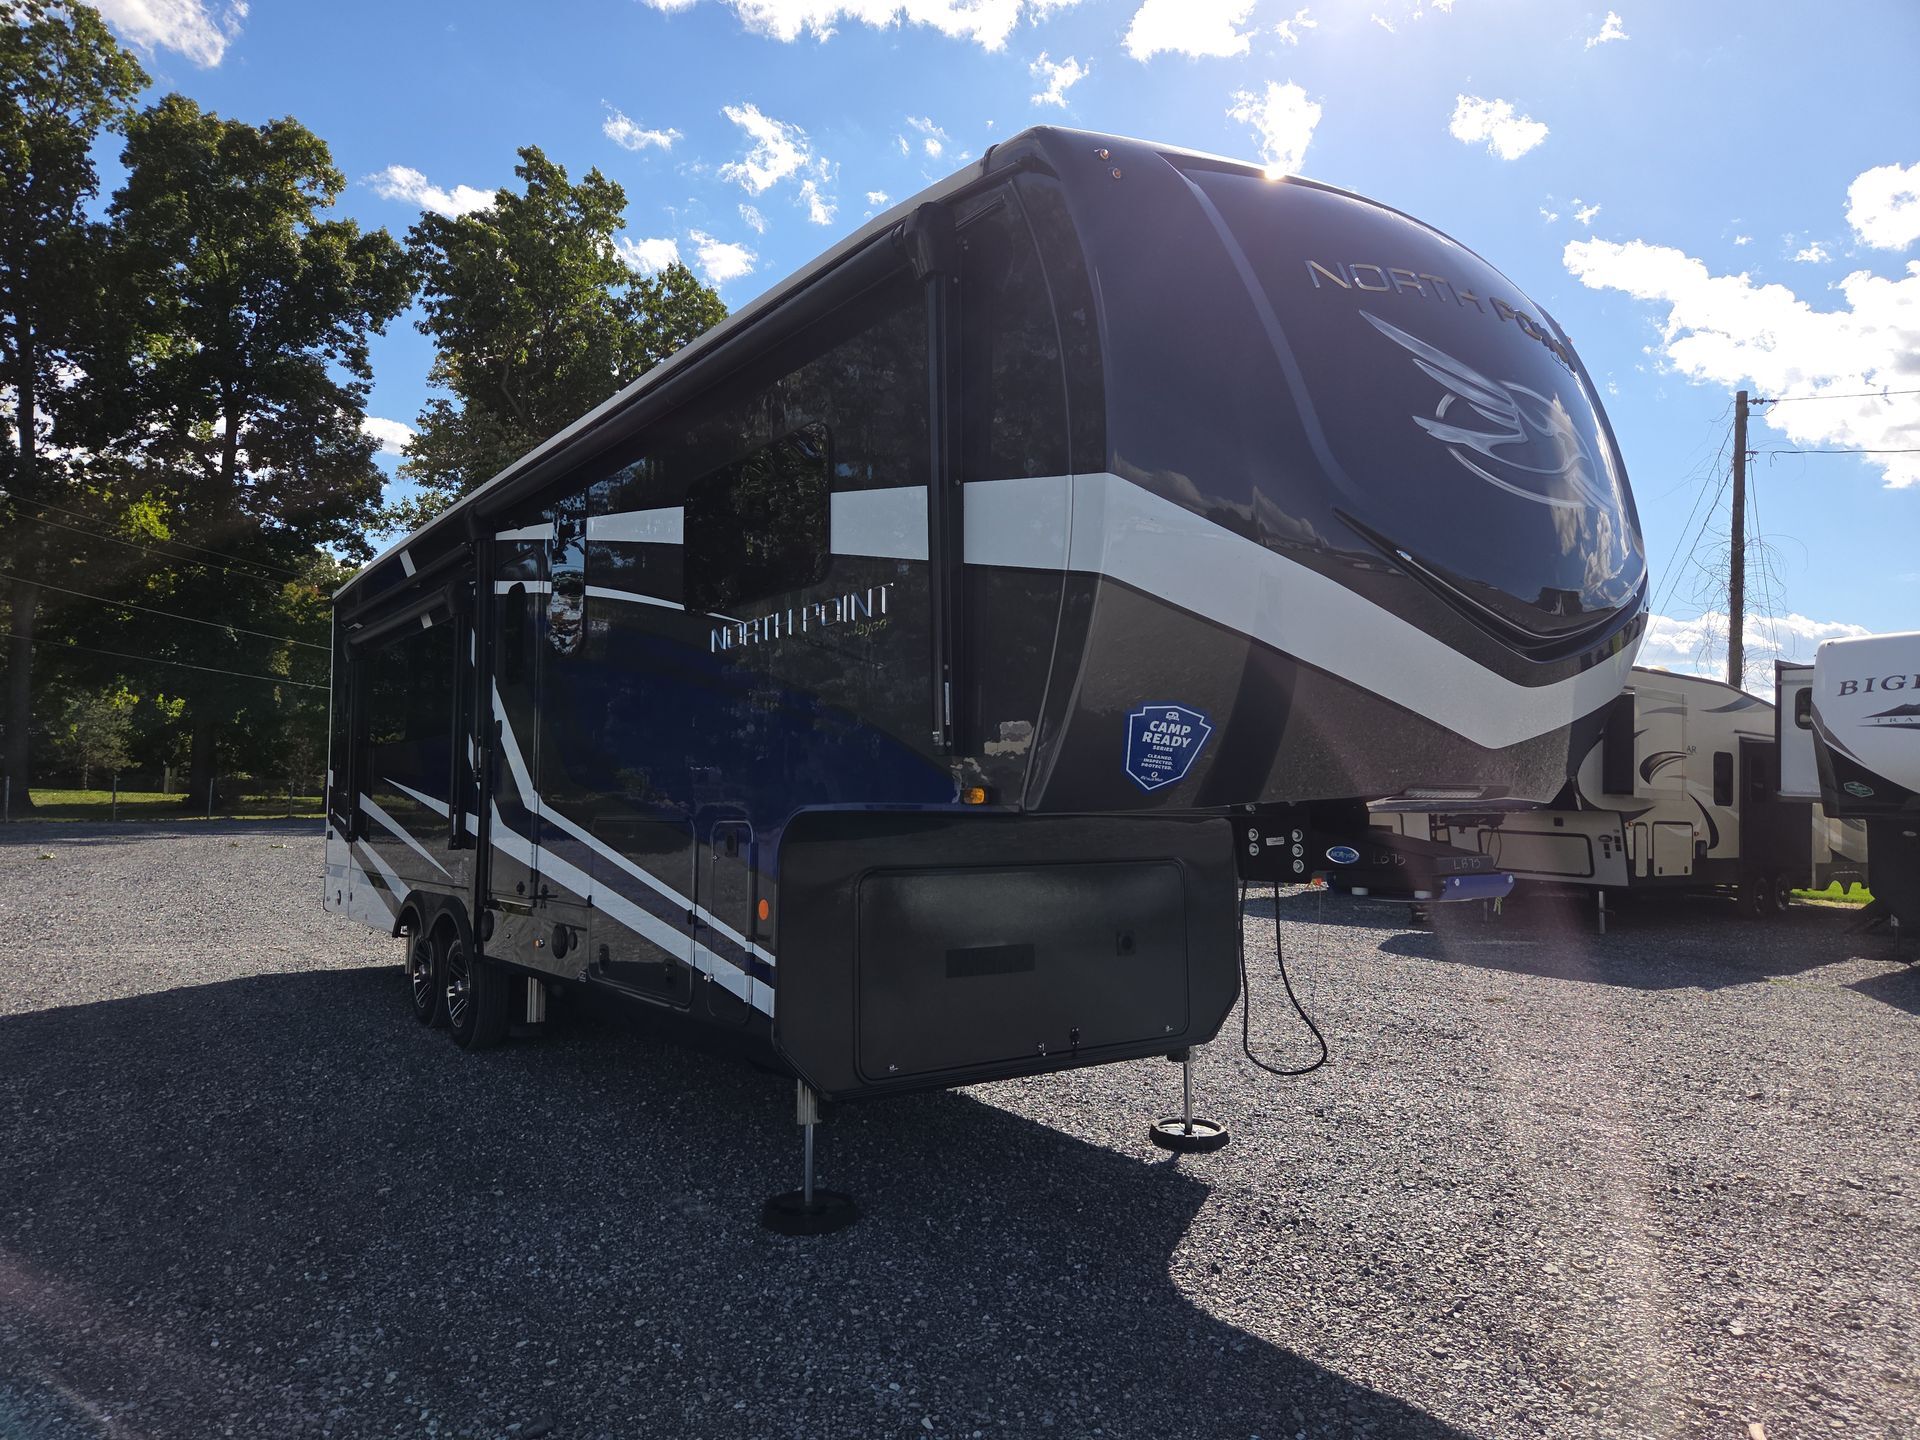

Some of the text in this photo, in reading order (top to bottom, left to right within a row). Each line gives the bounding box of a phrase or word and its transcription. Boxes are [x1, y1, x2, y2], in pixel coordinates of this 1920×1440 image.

[1304, 259, 1486, 314] NORTH
[710, 581, 894, 653] NORTH POINT
[1149, 720, 1192, 736] CAMP
[1141, 731, 1192, 748] READY
[1152, 744, 1173, 752] SERIES
